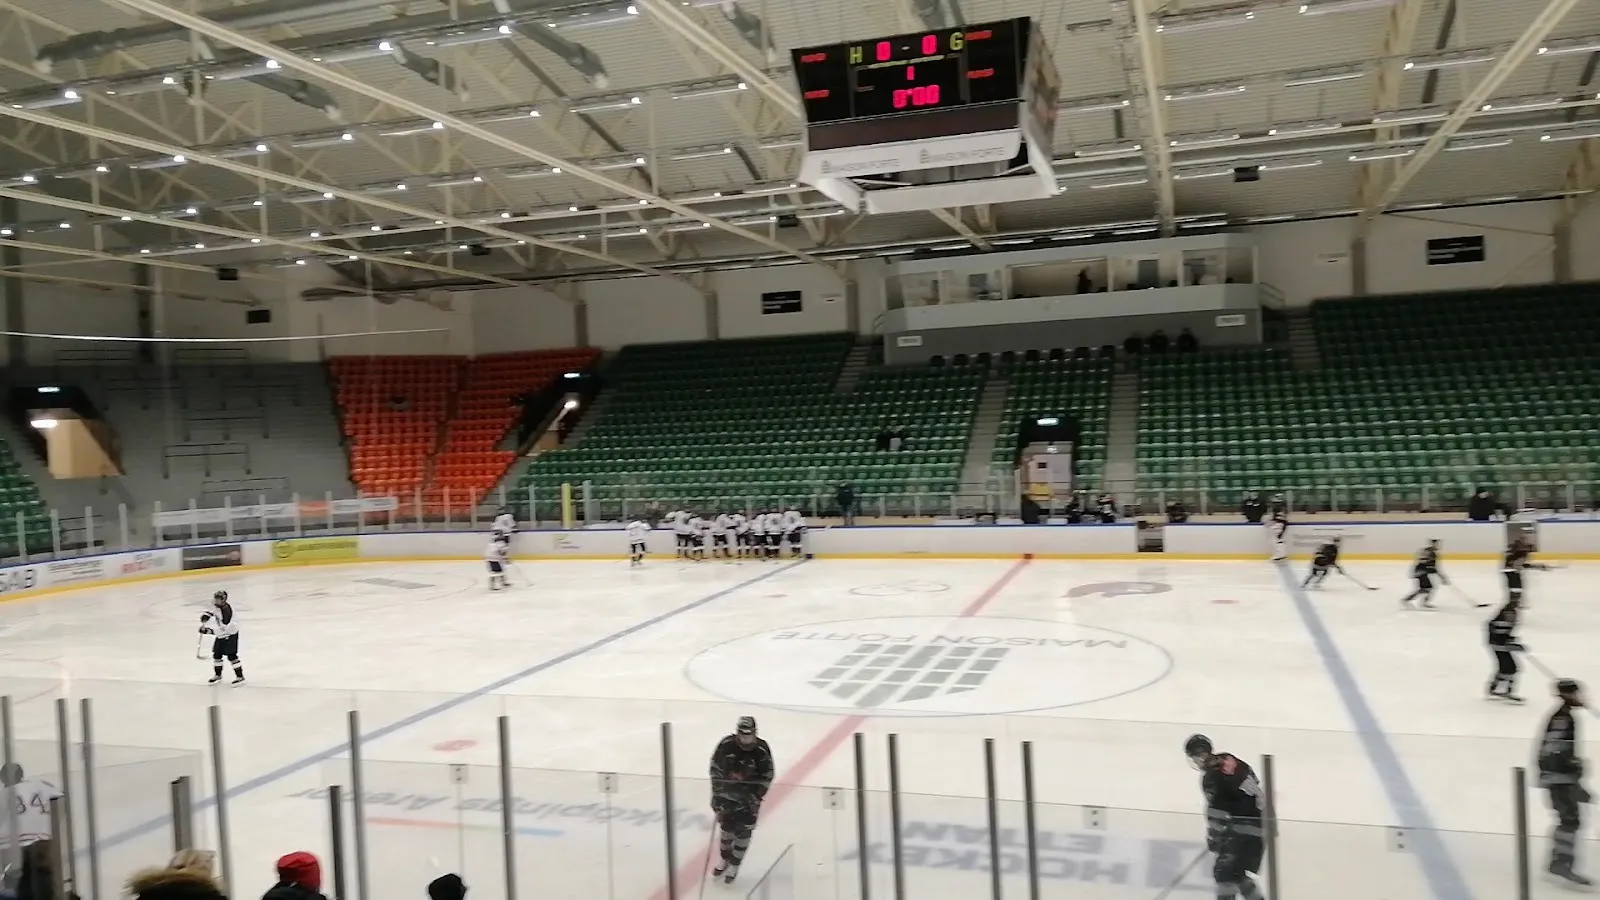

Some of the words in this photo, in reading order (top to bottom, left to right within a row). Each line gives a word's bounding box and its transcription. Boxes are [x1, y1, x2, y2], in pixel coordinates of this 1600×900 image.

[850, 46, 863, 64] H
[950, 32, 964, 50] G
[772, 631, 918, 643] FORTE
[930, 635, 1128, 648] MAISON
[836, 842, 1129, 886] HOCKEY
